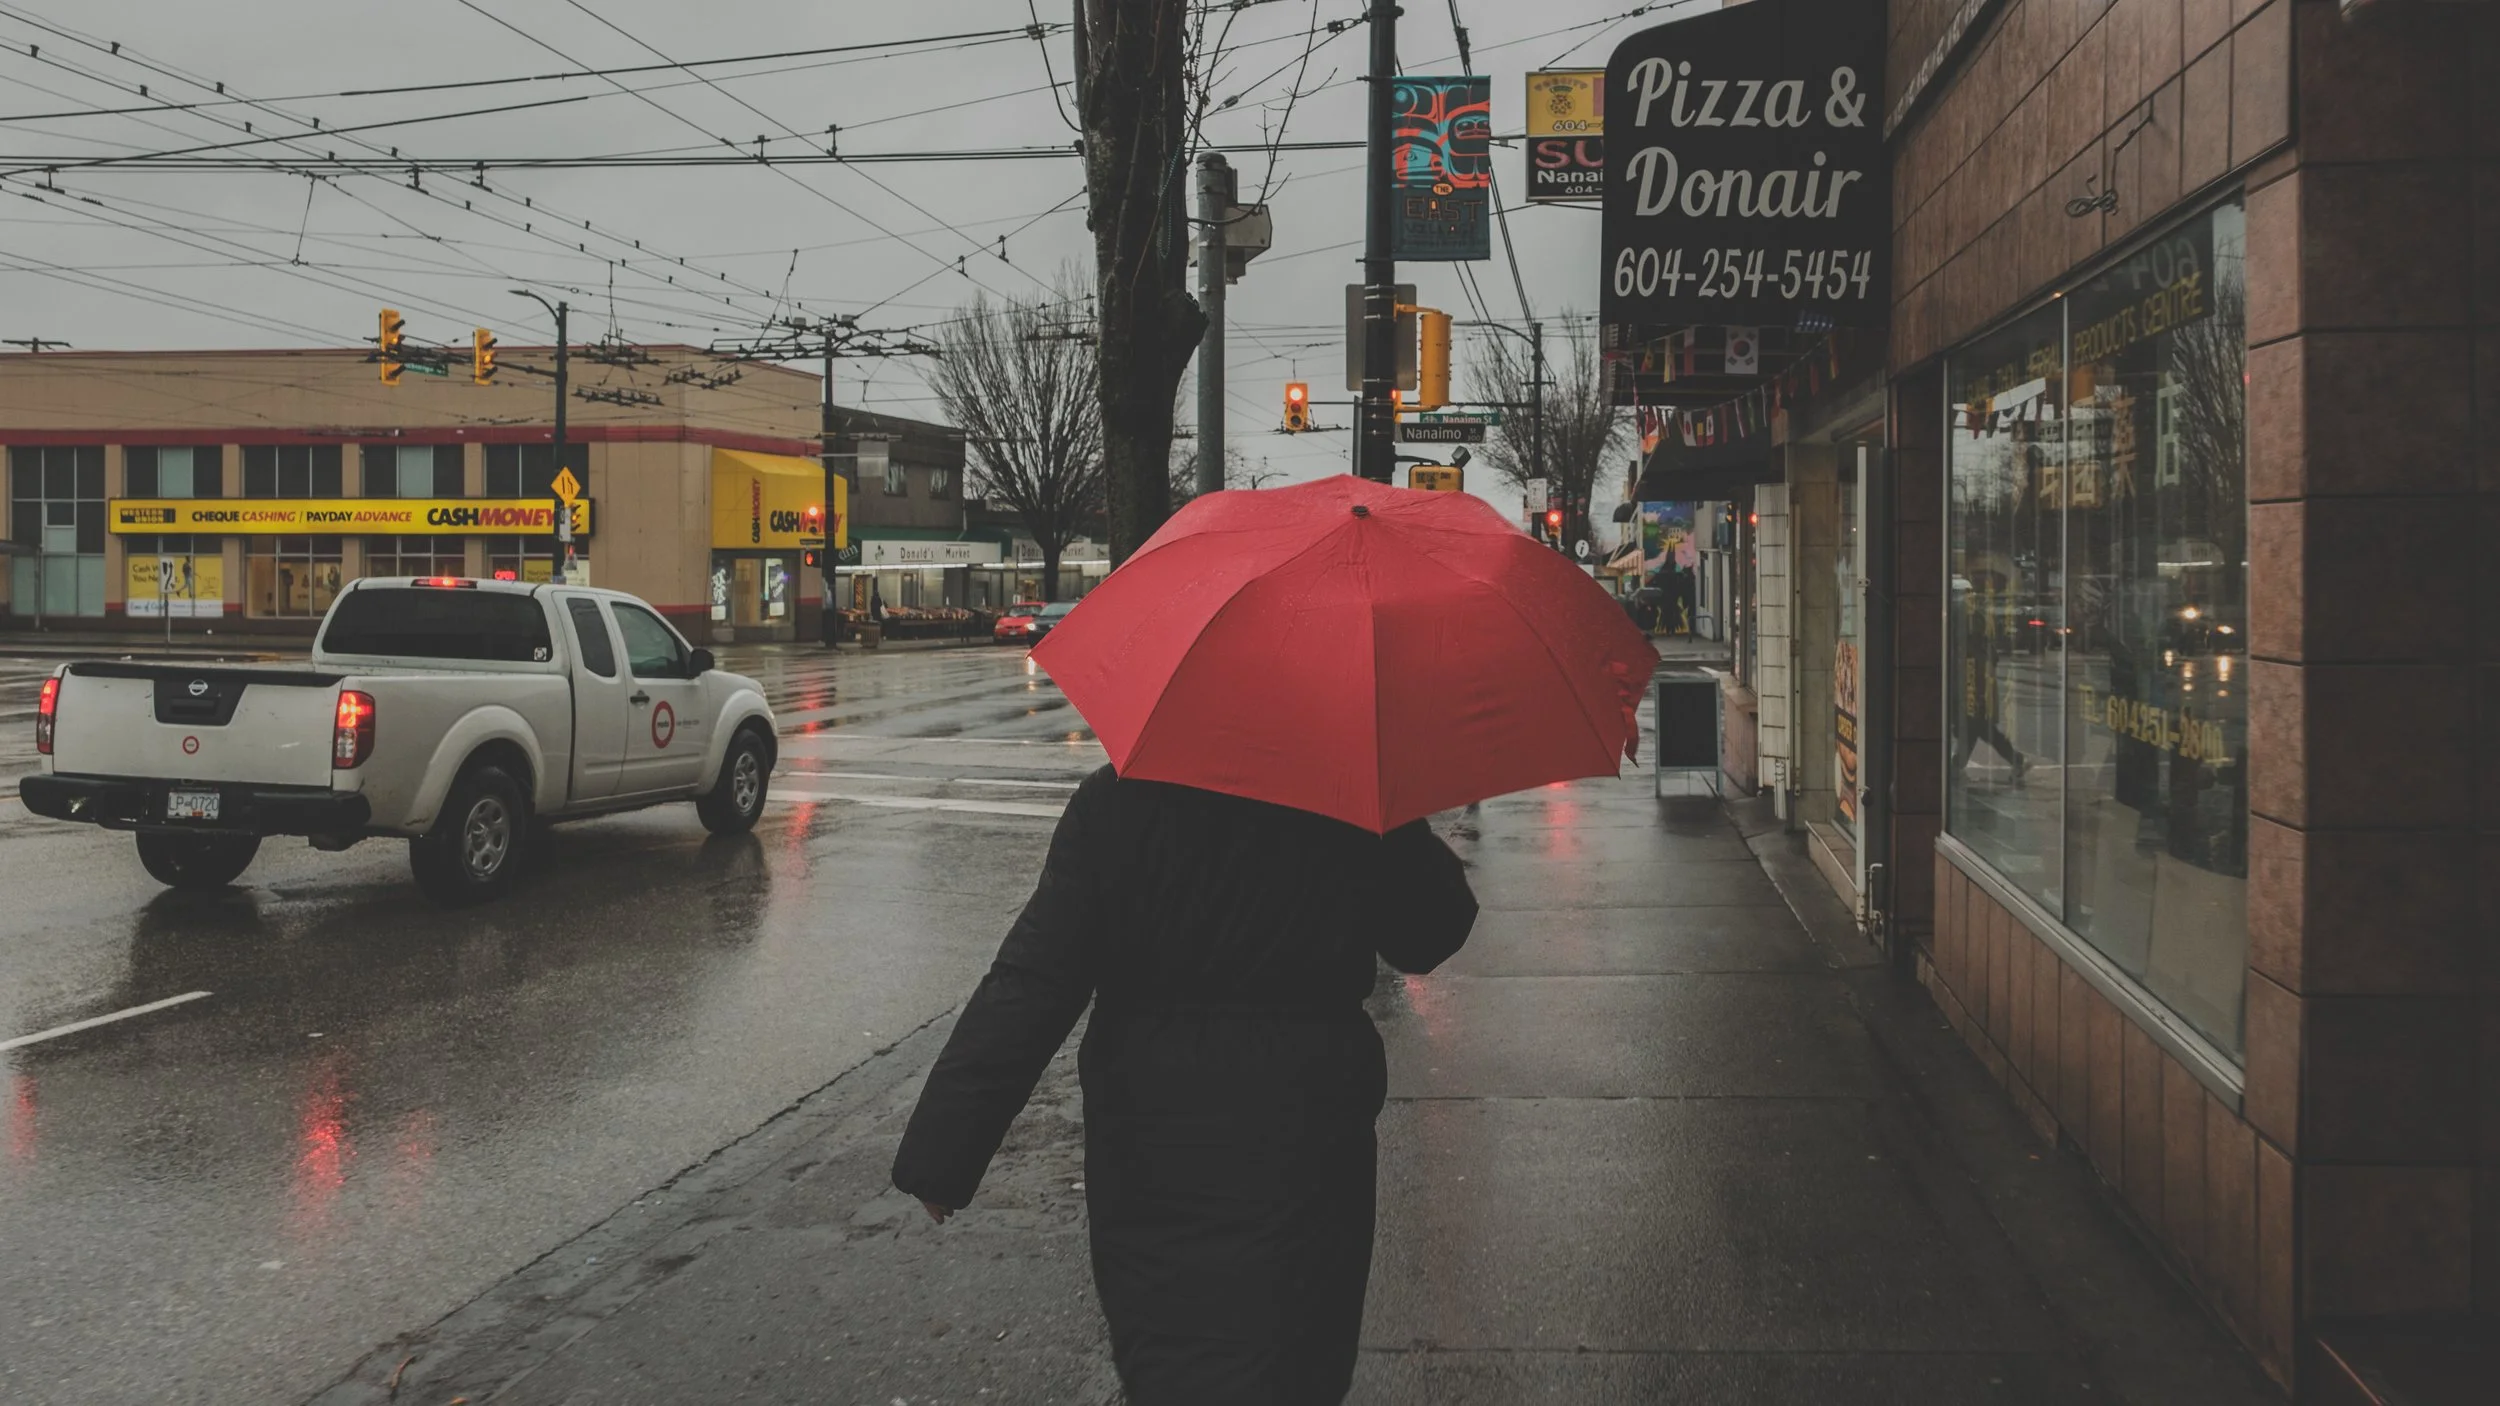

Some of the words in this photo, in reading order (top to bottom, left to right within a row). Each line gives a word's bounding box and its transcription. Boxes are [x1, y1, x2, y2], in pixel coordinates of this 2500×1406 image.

[1627, 57, 1811, 127] Pizza
[1824, 66, 1866, 127] &
[1552, 119, 1604, 132] 604-
[1625, 146, 1863, 218] Donair
[1406, 197, 1483, 221] EAST
[1614, 247, 1871, 299] 604-254-5454
[2074, 306, 2137, 364] PRODUCTS
[2142, 271, 2203, 336] CENTRE
[1443, 415, 1482, 424] Nanaimo
[1406, 426, 1461, 440] Nanaimo
[192, 511, 240, 523] CHEQUE
[242, 511, 296, 522] CASHING
[306, 511, 353, 522] PAYDAY
[354, 511, 412, 522] ADVANCE
[901, 547, 934, 559] Donald's
[945, 548, 970, 559] Market
